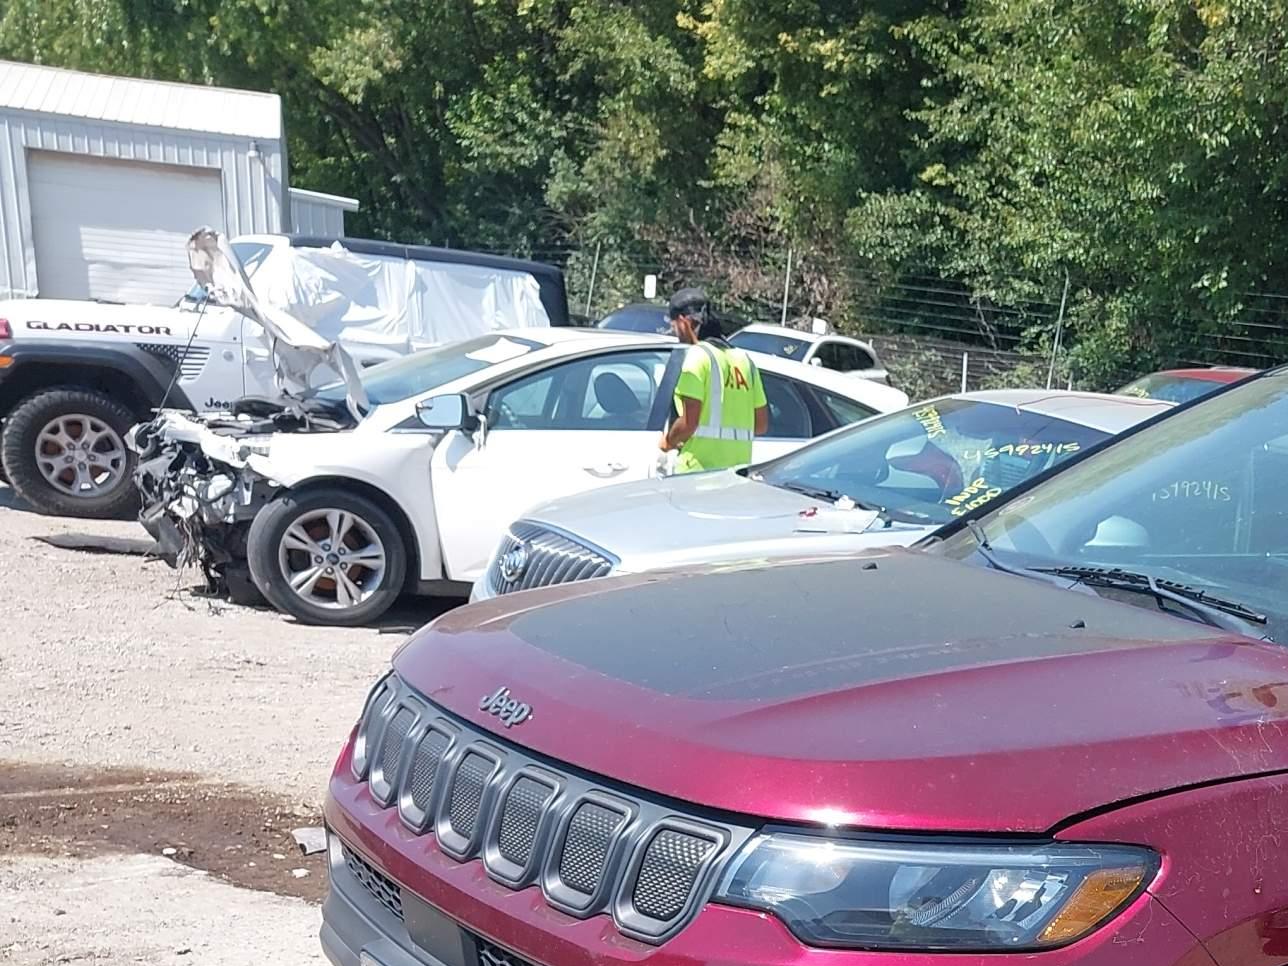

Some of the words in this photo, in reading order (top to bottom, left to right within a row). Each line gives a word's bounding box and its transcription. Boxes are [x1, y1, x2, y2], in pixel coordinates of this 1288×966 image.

[26, 320, 173, 336] GLADIATOR
[204, 397, 233, 411] Jee
[480, 686, 531, 729] Jeep
